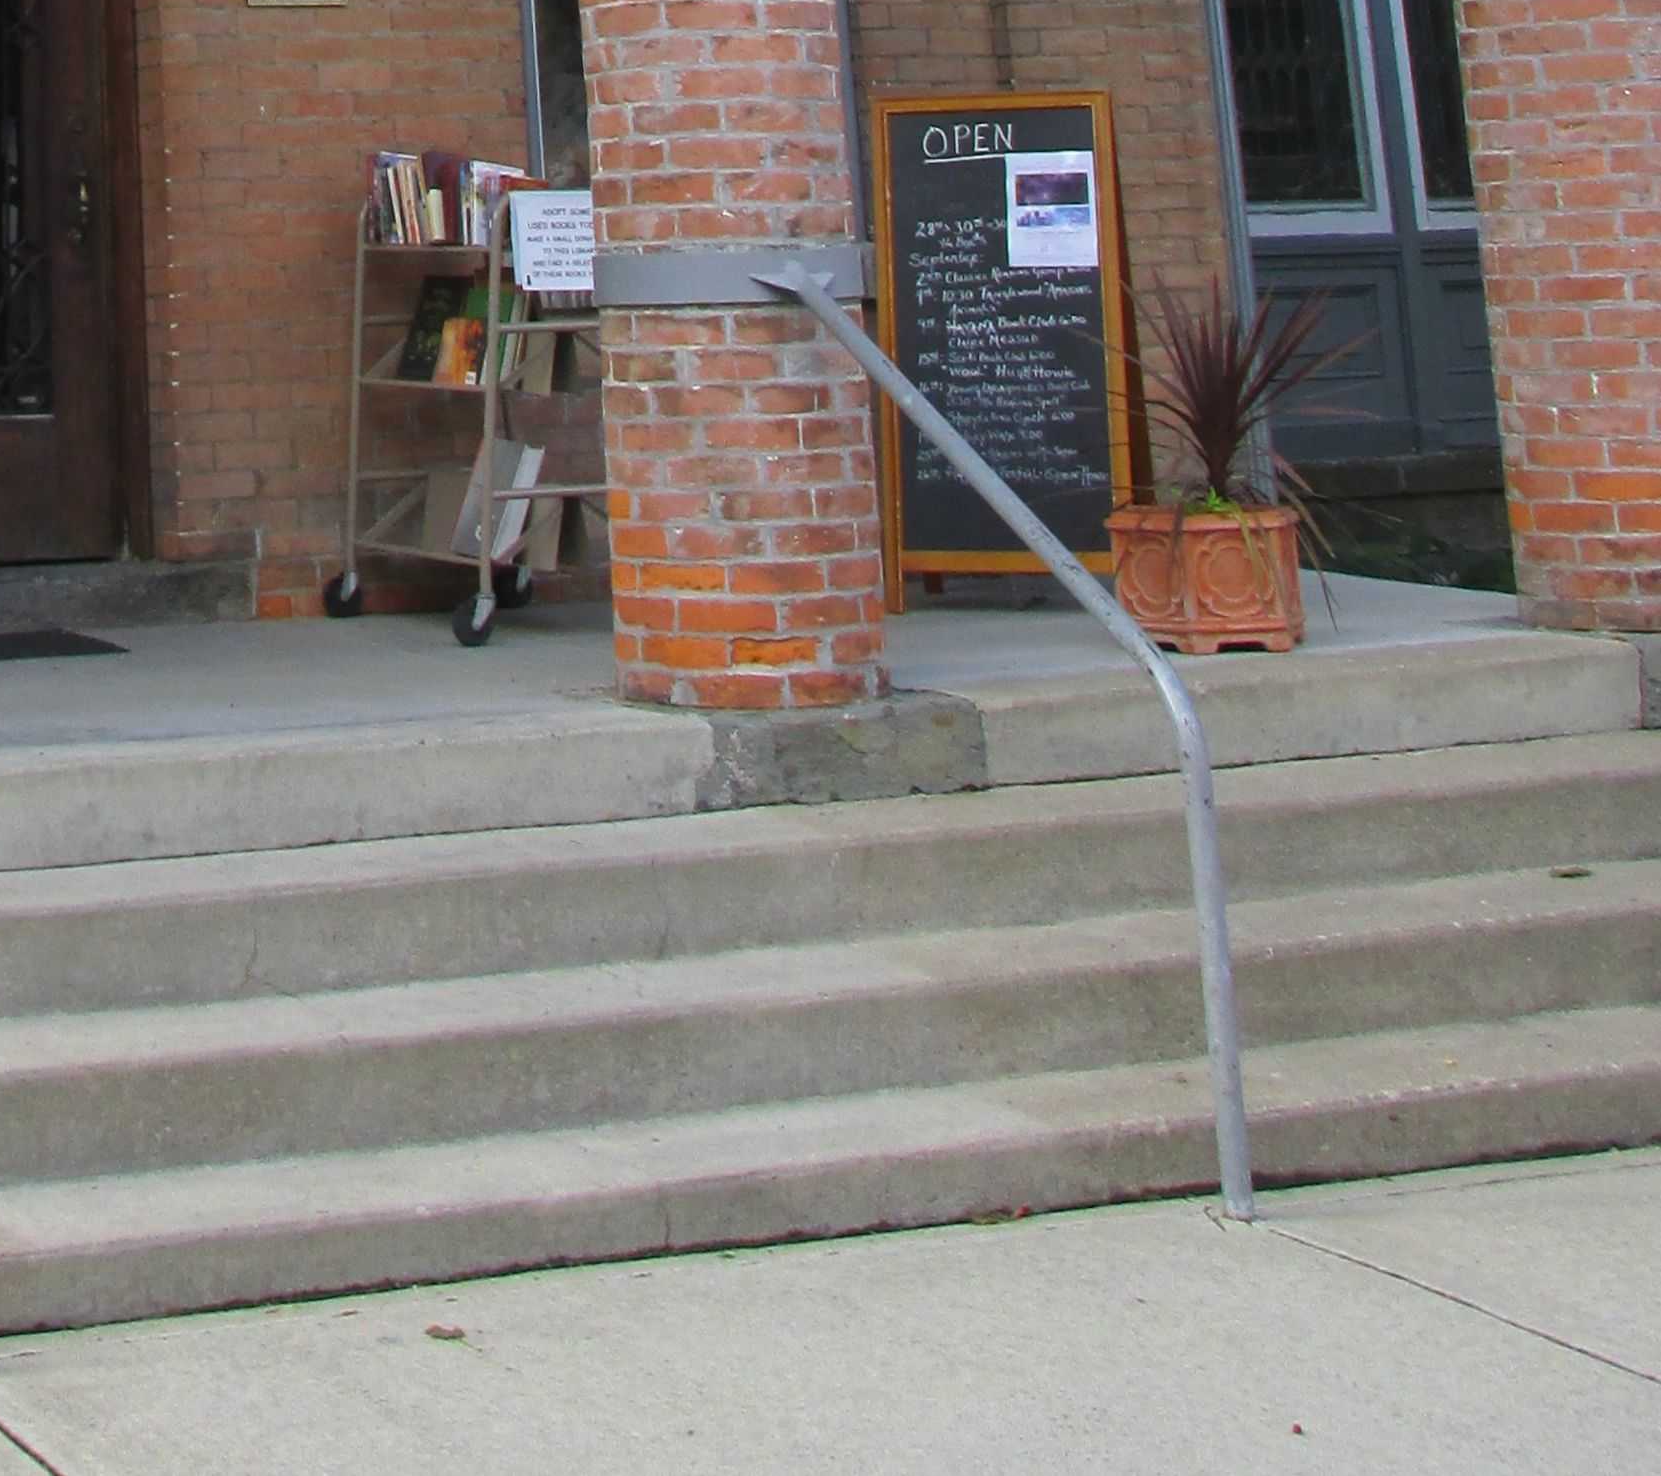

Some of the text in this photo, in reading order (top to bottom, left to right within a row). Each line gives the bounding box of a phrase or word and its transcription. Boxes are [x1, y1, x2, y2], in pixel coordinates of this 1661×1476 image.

[922, 123, 1013, 158] OPEN
[542, 208, 591, 216] ADOPT SOME
[527, 221, 548, 230] USED
[551, 221, 576, 229] BOOKS
